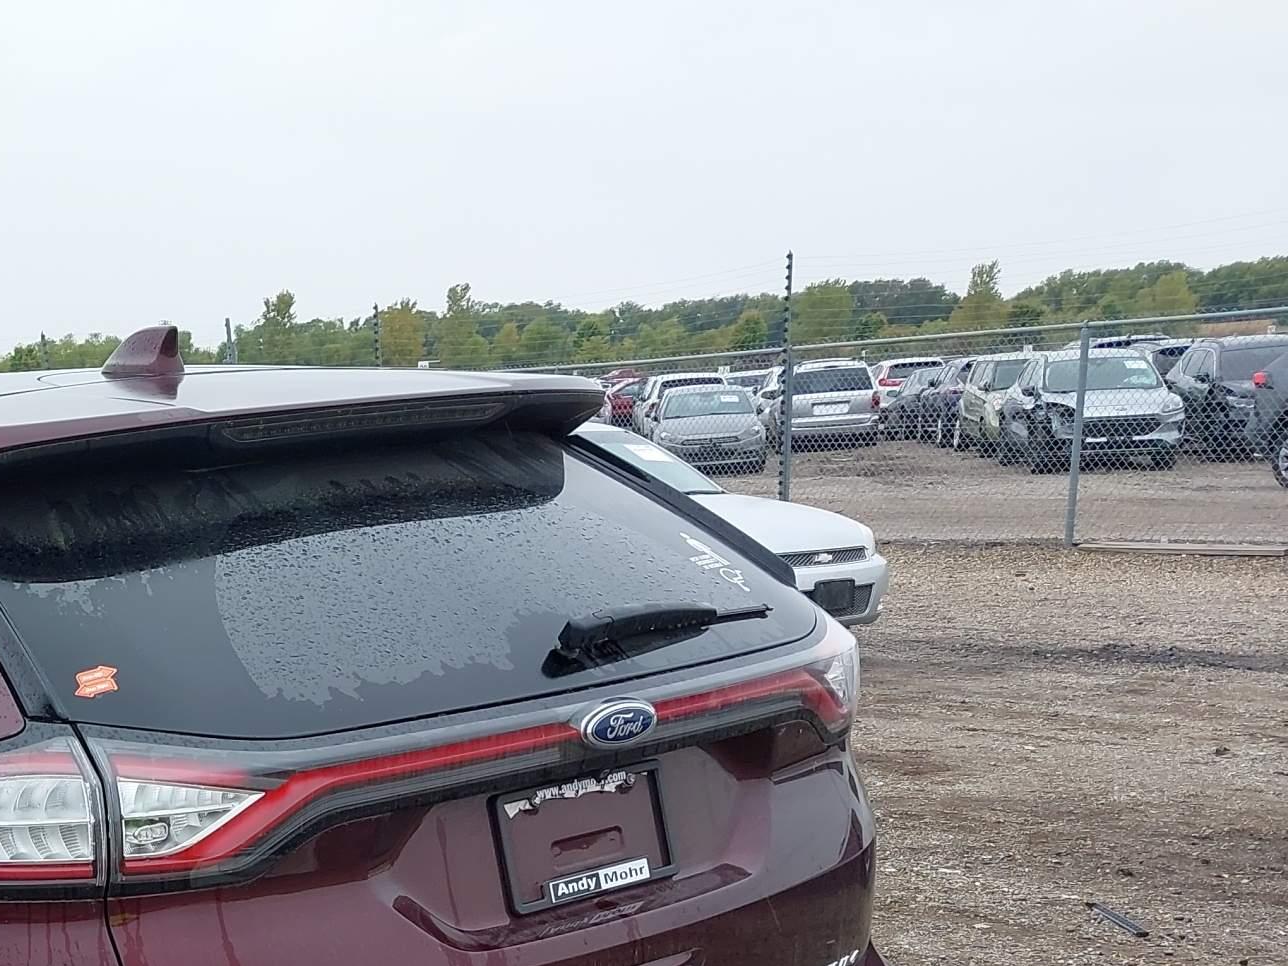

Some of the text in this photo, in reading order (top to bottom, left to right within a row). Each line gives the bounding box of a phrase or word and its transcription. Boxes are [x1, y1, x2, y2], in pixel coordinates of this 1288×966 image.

[606, 712, 644, 739] Ford
[536, 770, 627, 798] www.andymo.com
[557, 864, 645, 897] Andy Mohr
